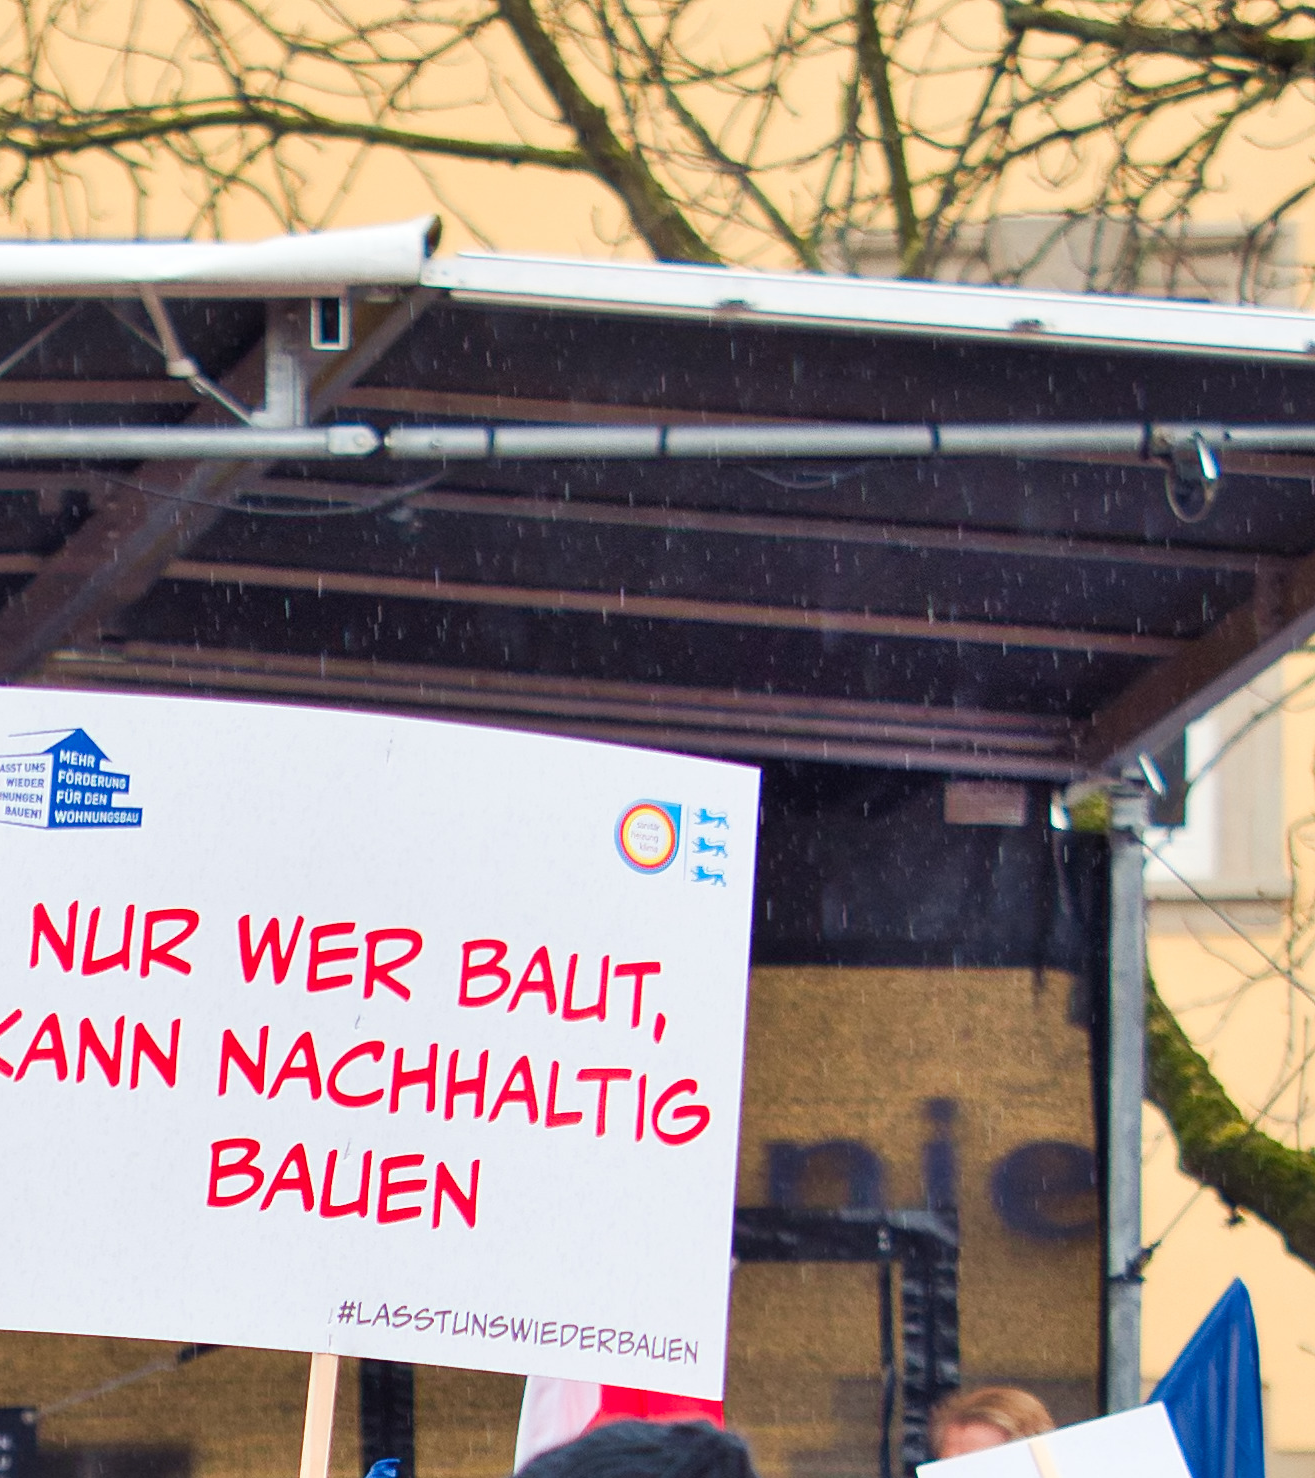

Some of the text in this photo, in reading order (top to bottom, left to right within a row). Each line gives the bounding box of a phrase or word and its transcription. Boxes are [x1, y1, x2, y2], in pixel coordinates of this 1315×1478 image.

[24, 762, 46, 773] UNS
[59, 749, 96, 768] MEHR
[6, 777, 45, 789] WIEDER
[57, 769, 127, 790] FÖRDERUNG
[56, 788, 108, 806] FÜR DEN
[54, 809, 140, 824] WOHNUNGSBAU
[29, 900, 667, 1044] NUR WER BAUT,
[218, 1024, 712, 1147] NACHHALTIG
[206, 1137, 481, 1230] BAUEN
[337, 1300, 699, 1365] #LASSTUNSWIEDERBAUEN
